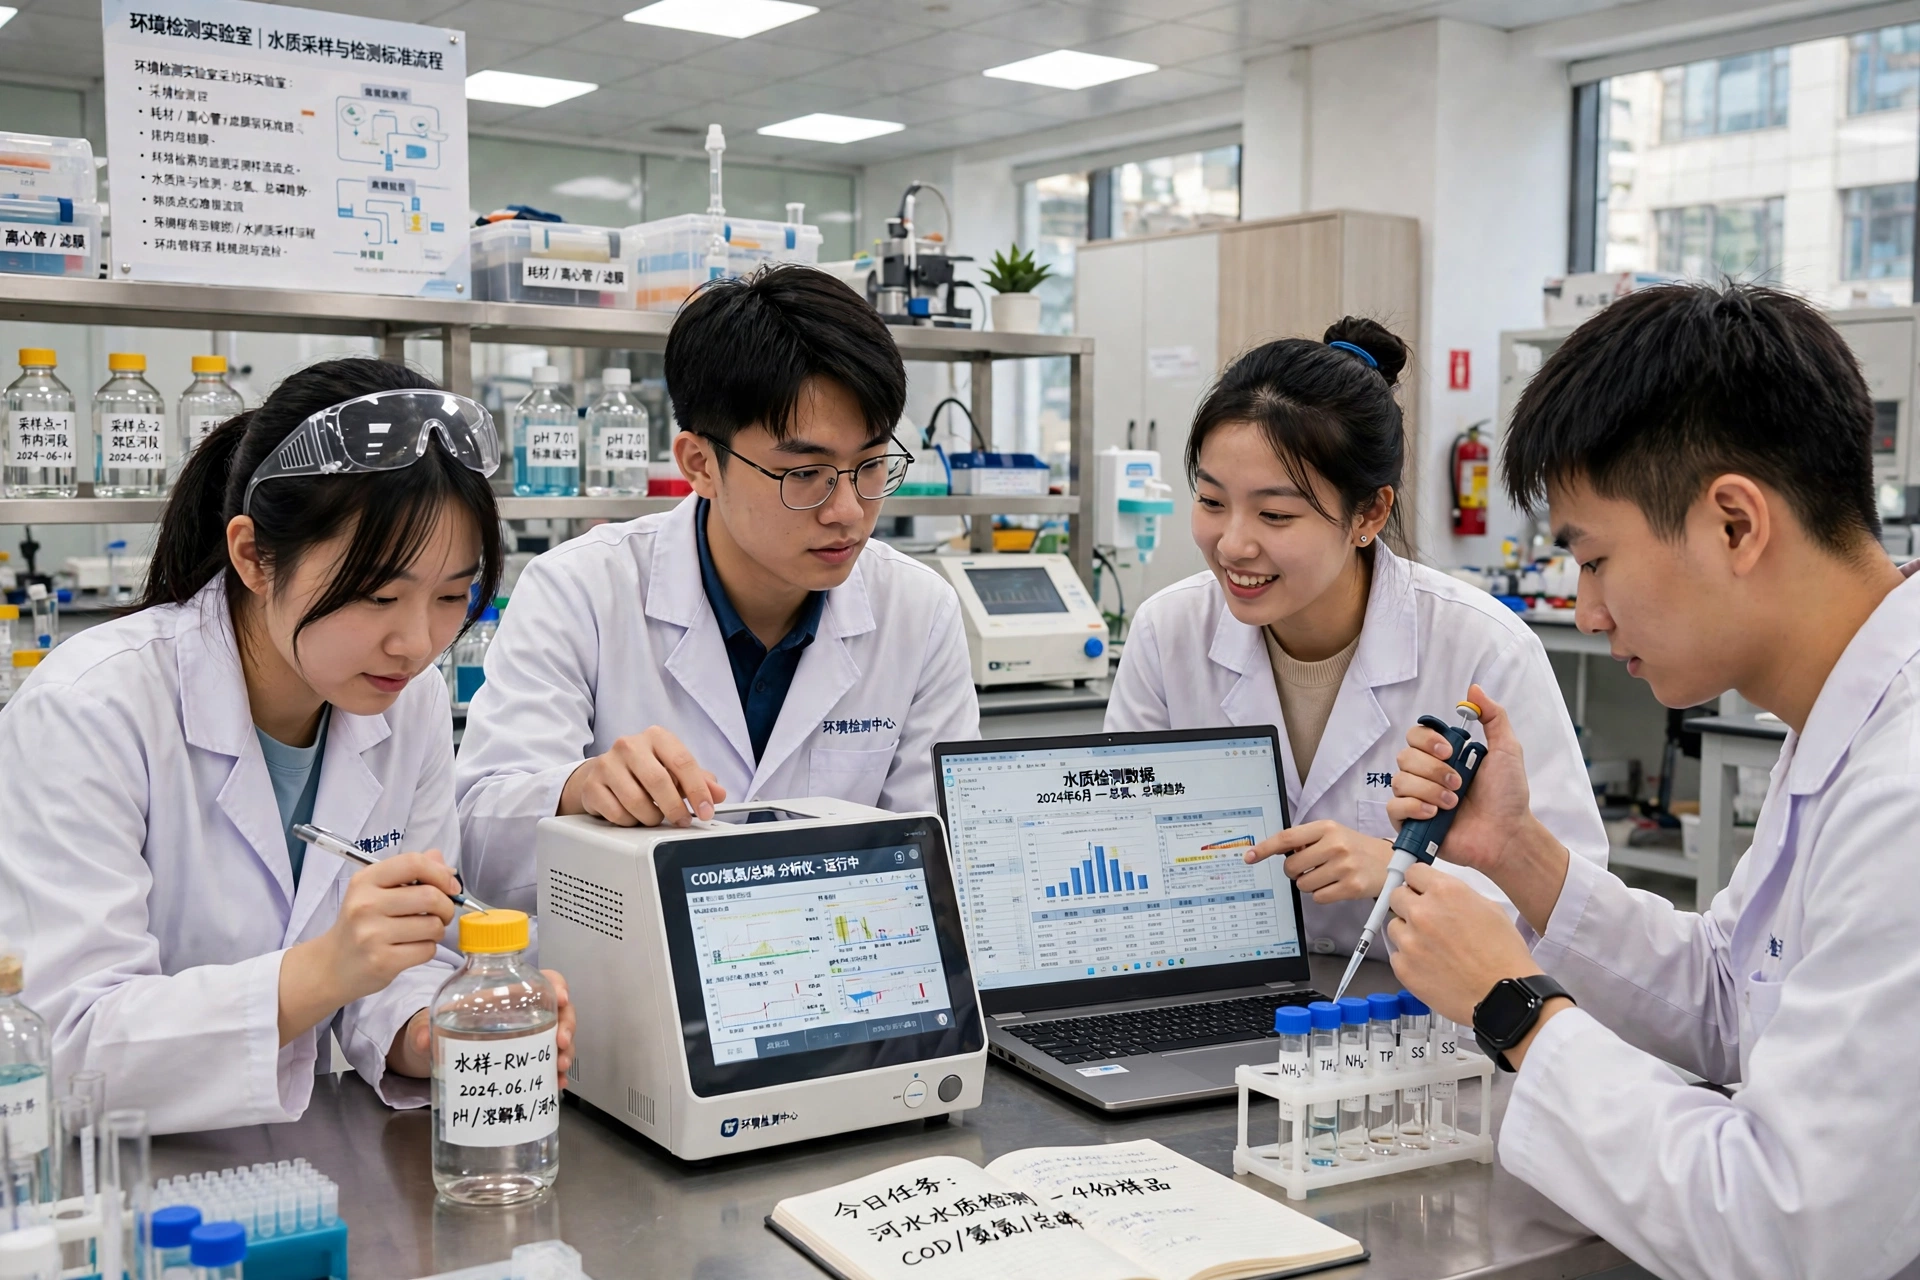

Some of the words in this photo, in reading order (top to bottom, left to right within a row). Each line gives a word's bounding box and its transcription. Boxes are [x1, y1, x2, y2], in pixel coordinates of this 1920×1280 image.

[130, 12, 253, 46] 环境检测实验室
[268, 30, 444, 71] 水质采样与检测标准流程
[5, 229, 47, 247] 离心管
[527, 265, 549, 280] 耗材
[561, 267, 593, 283] 离心管
[18, 416, 67, 431] 采样点-1
[110, 418, 160, 432] 采样点-2
[19, 433, 68, 449] 市内河段
[534, 432, 549, 445] pH
[554, 432, 574, 444] 7.01
[607, 434, 623, 446] pH
[17, 451, 72, 462] 2024-06-14
[823, 717, 897, 735] 环境检测中心
[1063, 766, 1156, 788] 水质检测数据
[1036, 788, 1092, 804] 2024年6月
[823, 855, 860, 873] 运行中
[1411, 1046, 1425, 1059] SS
[1441, 1041, 1455, 1054] SS
[454, 1045, 551, 1075] 水样-RW-06
[1379, 1051, 1394, 1063] TP
[460, 1075, 543, 1097] 2024.06.14
[867, 1191, 1038, 1242] 河水水质检测
[1072, 1177, 1172, 1199] 4份样品
